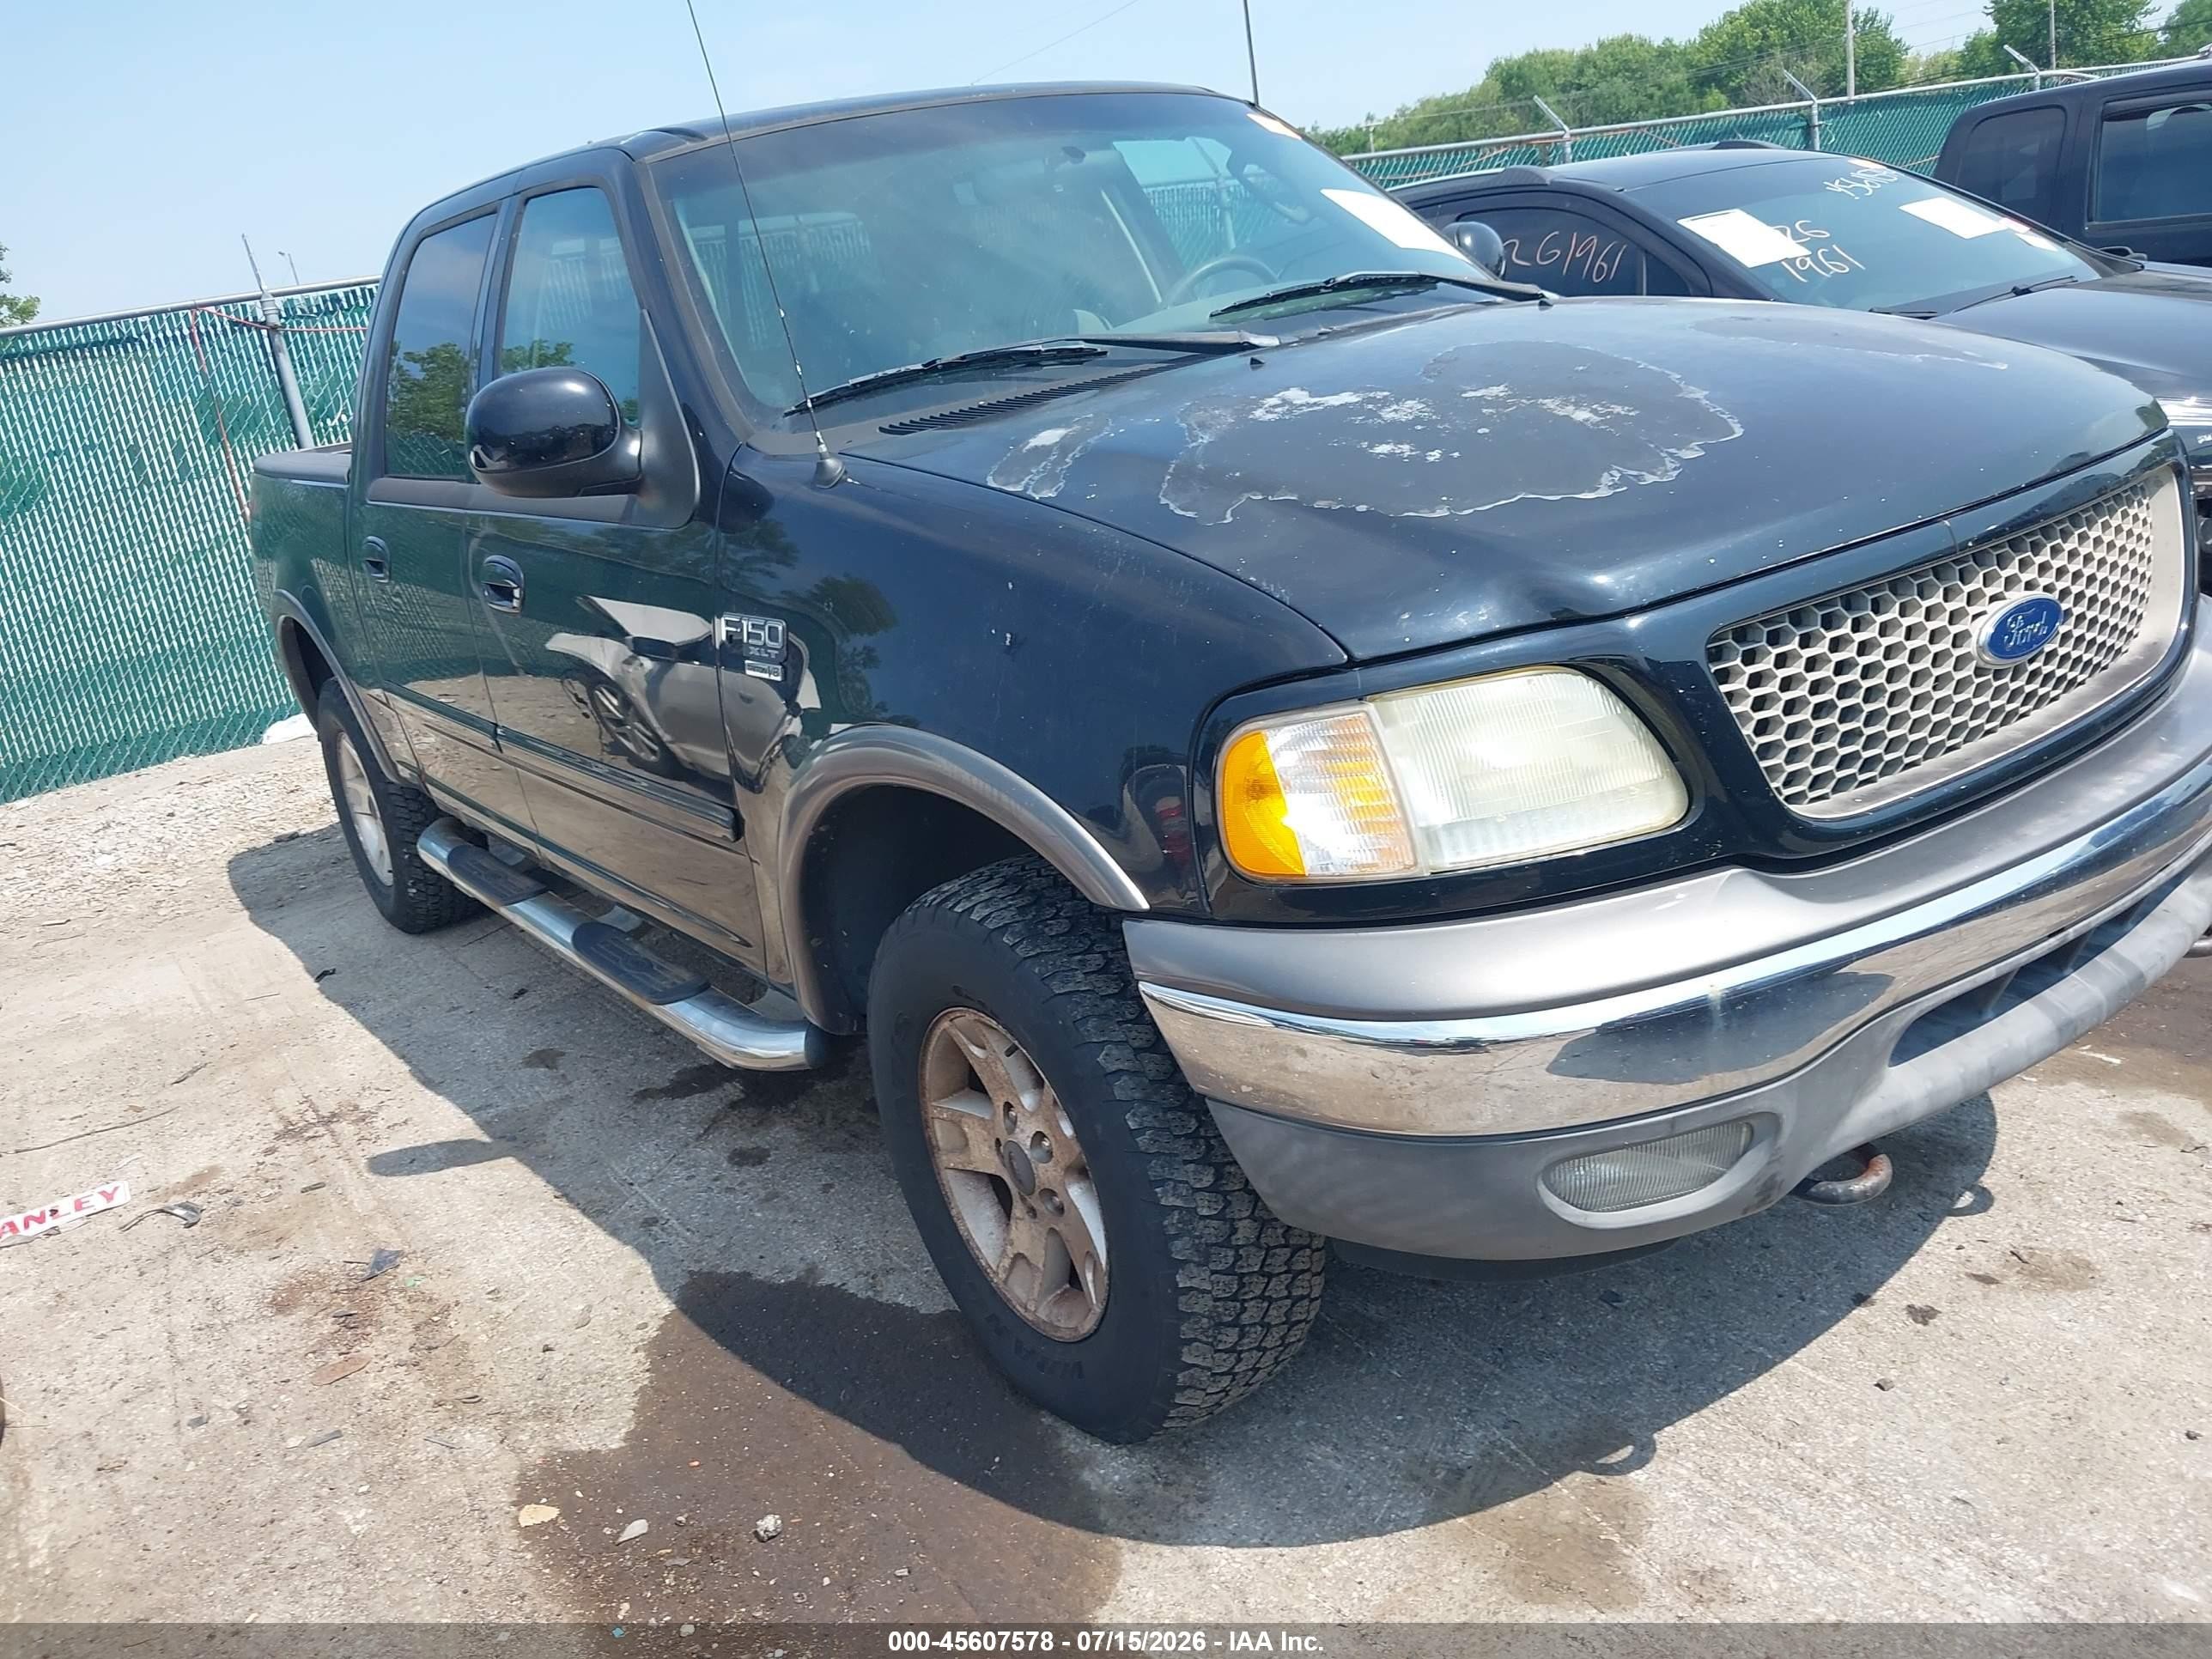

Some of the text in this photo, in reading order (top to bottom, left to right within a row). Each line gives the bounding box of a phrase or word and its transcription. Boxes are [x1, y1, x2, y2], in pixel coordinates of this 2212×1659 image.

[1781, 244, 1866, 283] 1961
[2003, 608, 2047, 651] Ford
[749, 646, 779, 659] XLT
